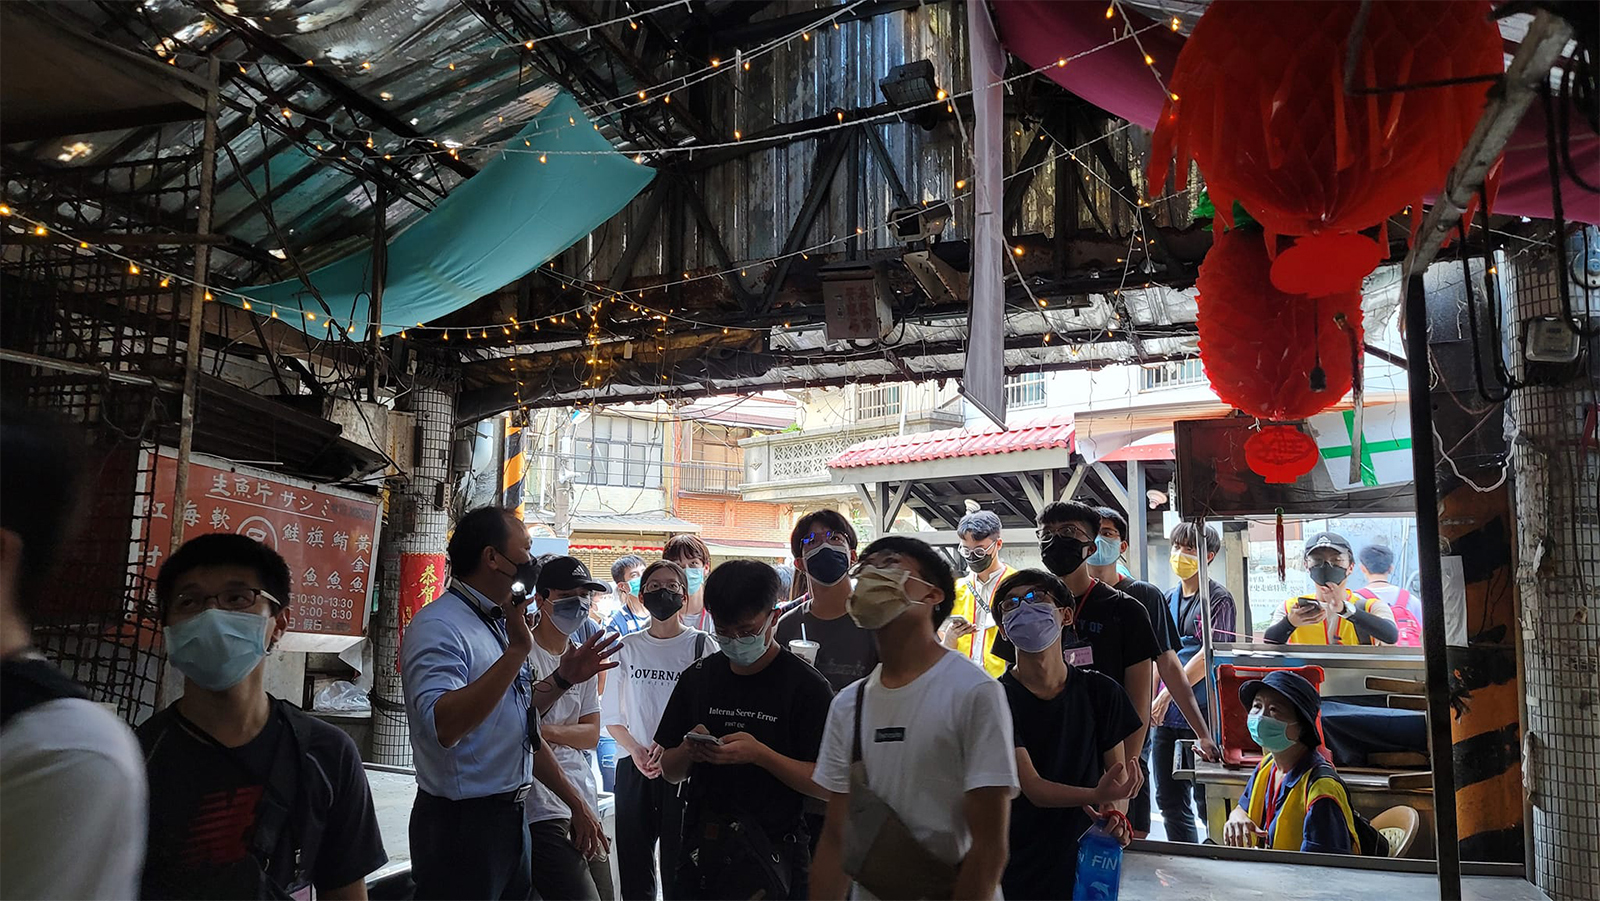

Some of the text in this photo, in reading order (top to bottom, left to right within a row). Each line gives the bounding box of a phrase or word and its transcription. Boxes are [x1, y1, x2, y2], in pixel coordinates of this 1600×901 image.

[210, 473, 273, 504] 生魚片
[280, 490, 330, 517] サシミ
[417, 563, 438, 608] 恭賀
[756, 711, 779, 722] Error
[1091, 855, 1118, 871] FIN
